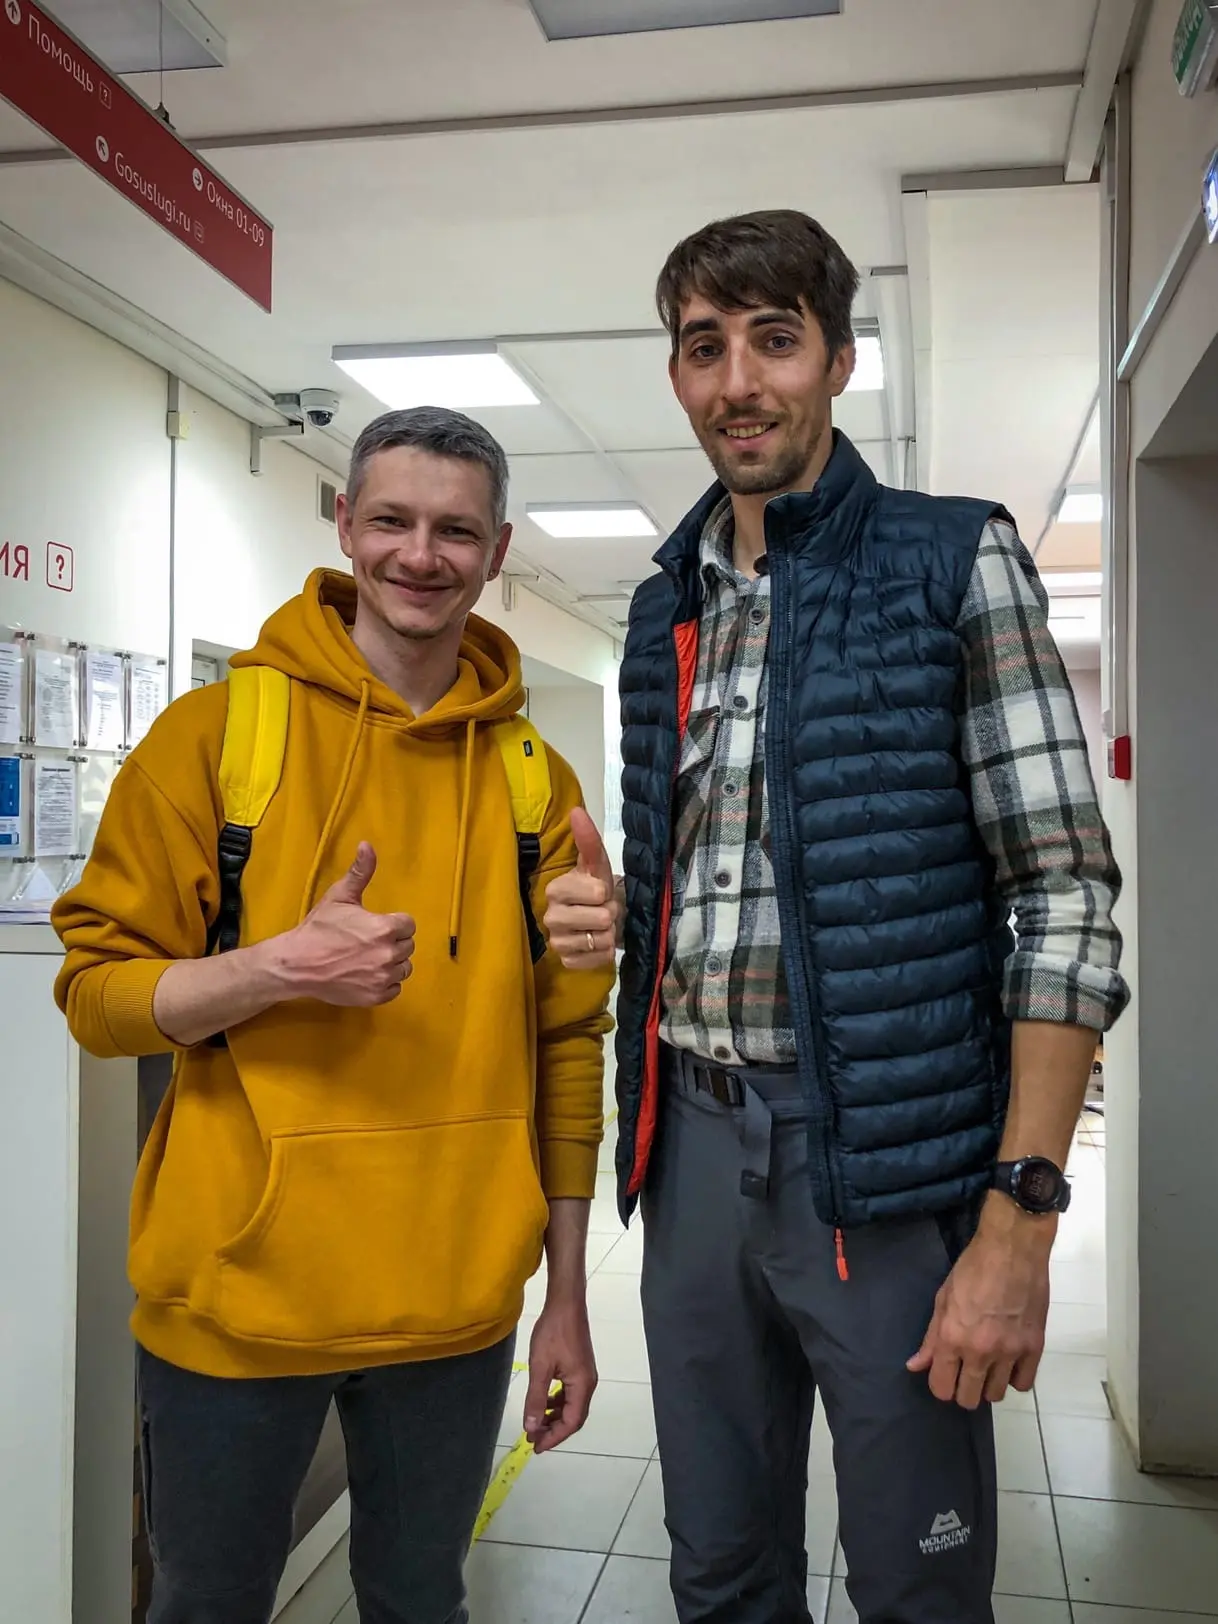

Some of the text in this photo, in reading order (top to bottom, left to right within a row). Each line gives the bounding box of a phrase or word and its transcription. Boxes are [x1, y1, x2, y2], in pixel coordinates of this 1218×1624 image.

[28, 13, 94, 93] Помощь
[115, 152, 191, 232] Gosuslugi.ru
[207, 181, 265, 247] Окна 01-09
[918, 1525, 971, 1550] MOUNTAIN
